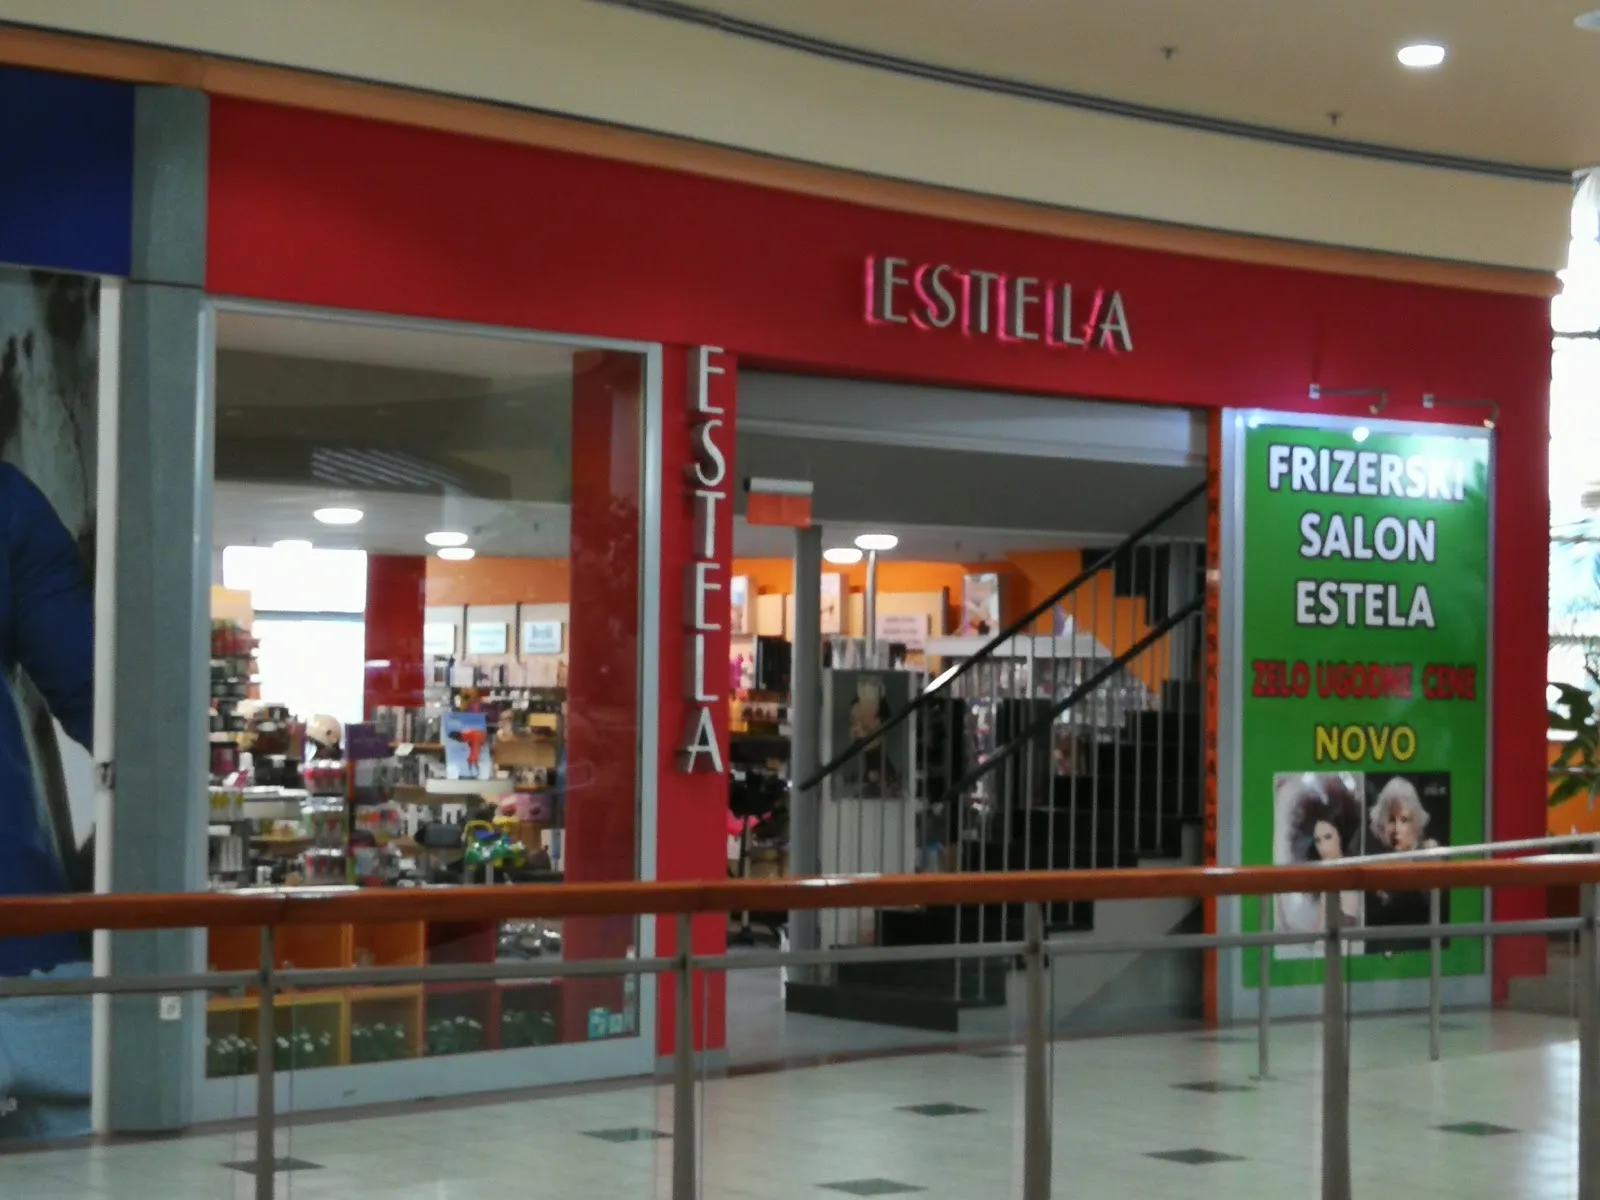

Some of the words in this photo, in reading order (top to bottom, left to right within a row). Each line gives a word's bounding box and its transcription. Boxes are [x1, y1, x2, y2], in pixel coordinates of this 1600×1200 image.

[882, 255, 1133, 351] ESTELA
[1267, 444, 1466, 501] FRIZERSKI
[687, 344, 726, 774] ESTELA
[1299, 512, 1436, 563] SALON
[1296, 580, 1436, 628] ESTELA
[1252, 660, 1310, 698] ZELO
[1317, 660, 1413, 699] UGODNE
[1422, 664, 1477, 700] CENE
[1315, 725, 1416, 762] NOVO
